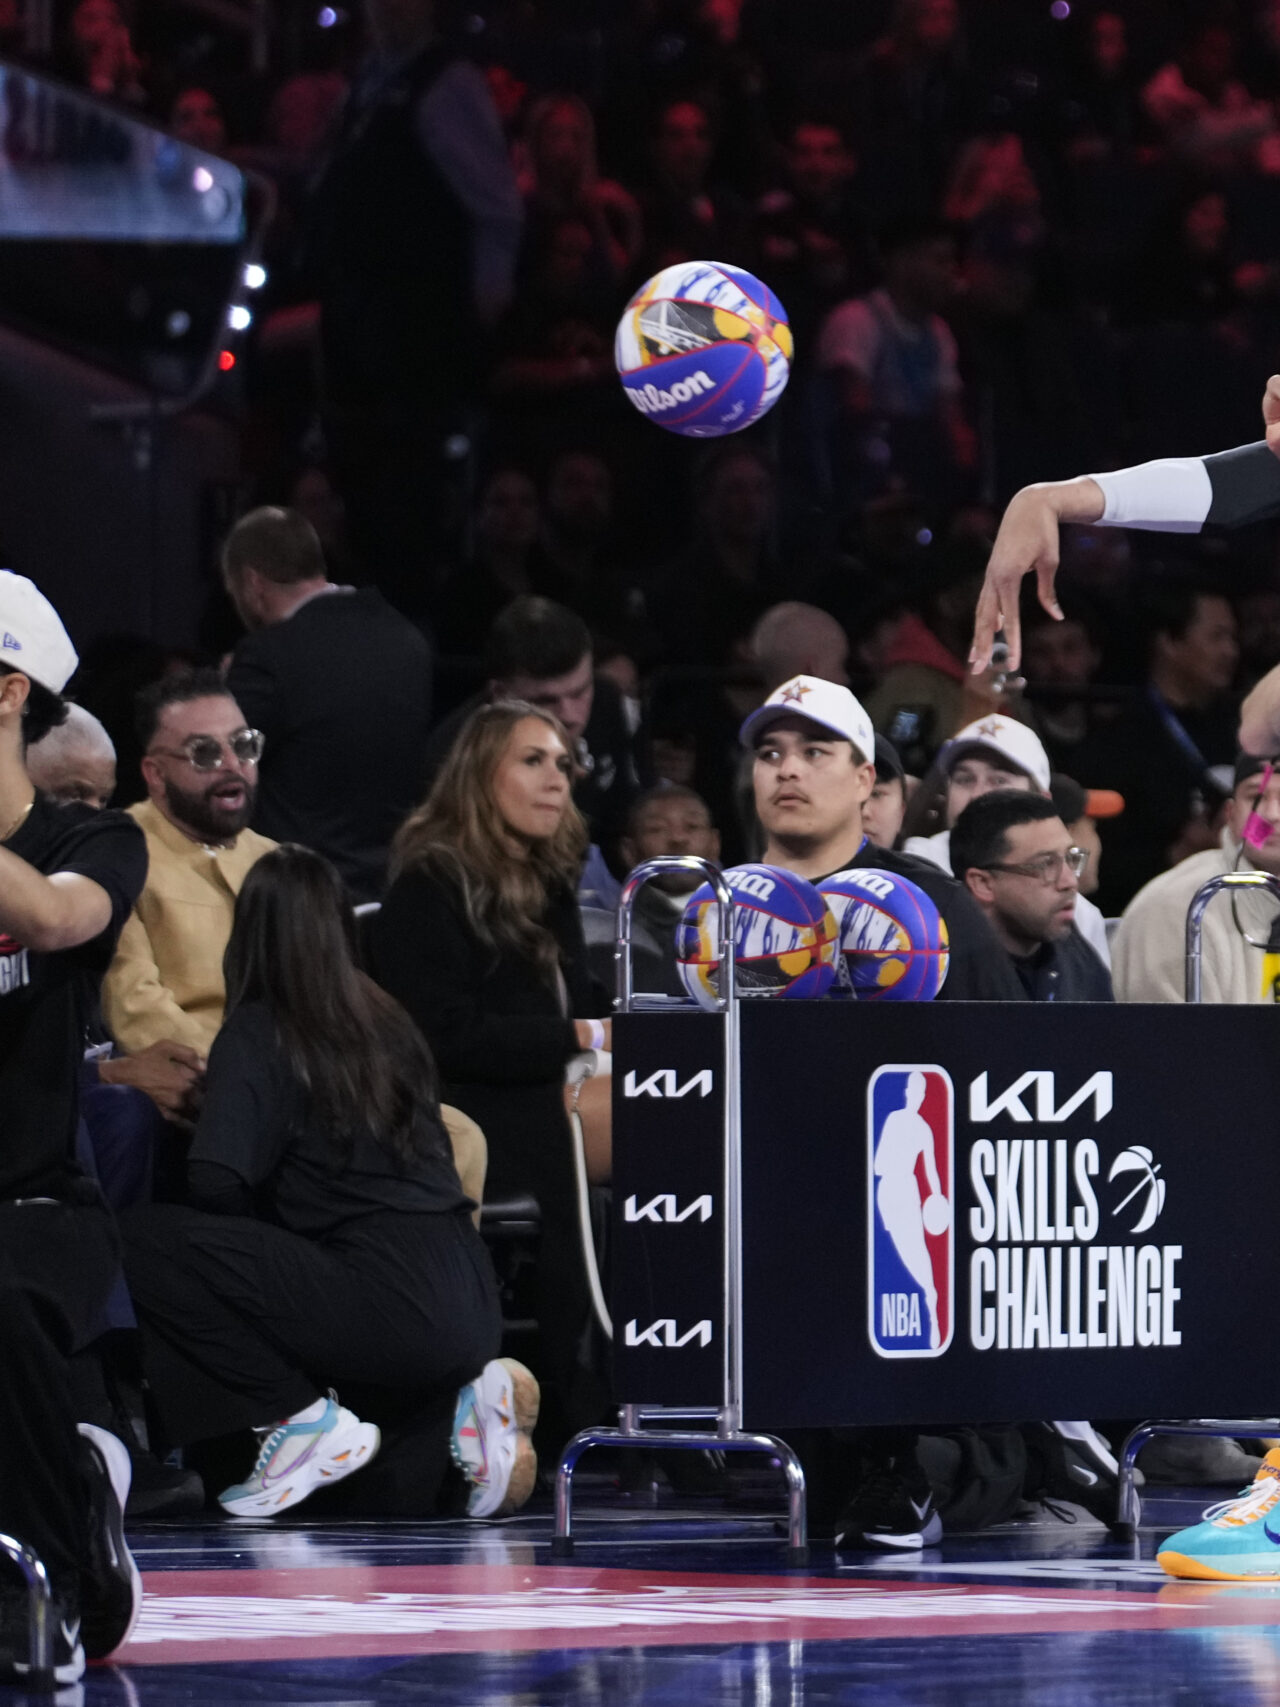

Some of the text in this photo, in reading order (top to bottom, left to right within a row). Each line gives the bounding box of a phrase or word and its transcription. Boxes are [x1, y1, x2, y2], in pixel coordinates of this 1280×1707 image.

[970, 1139, 1100, 1243] SKILLS
[881, 1293, 922, 1337] NBA
[970, 1245, 1183, 1351] CHALLENGE
